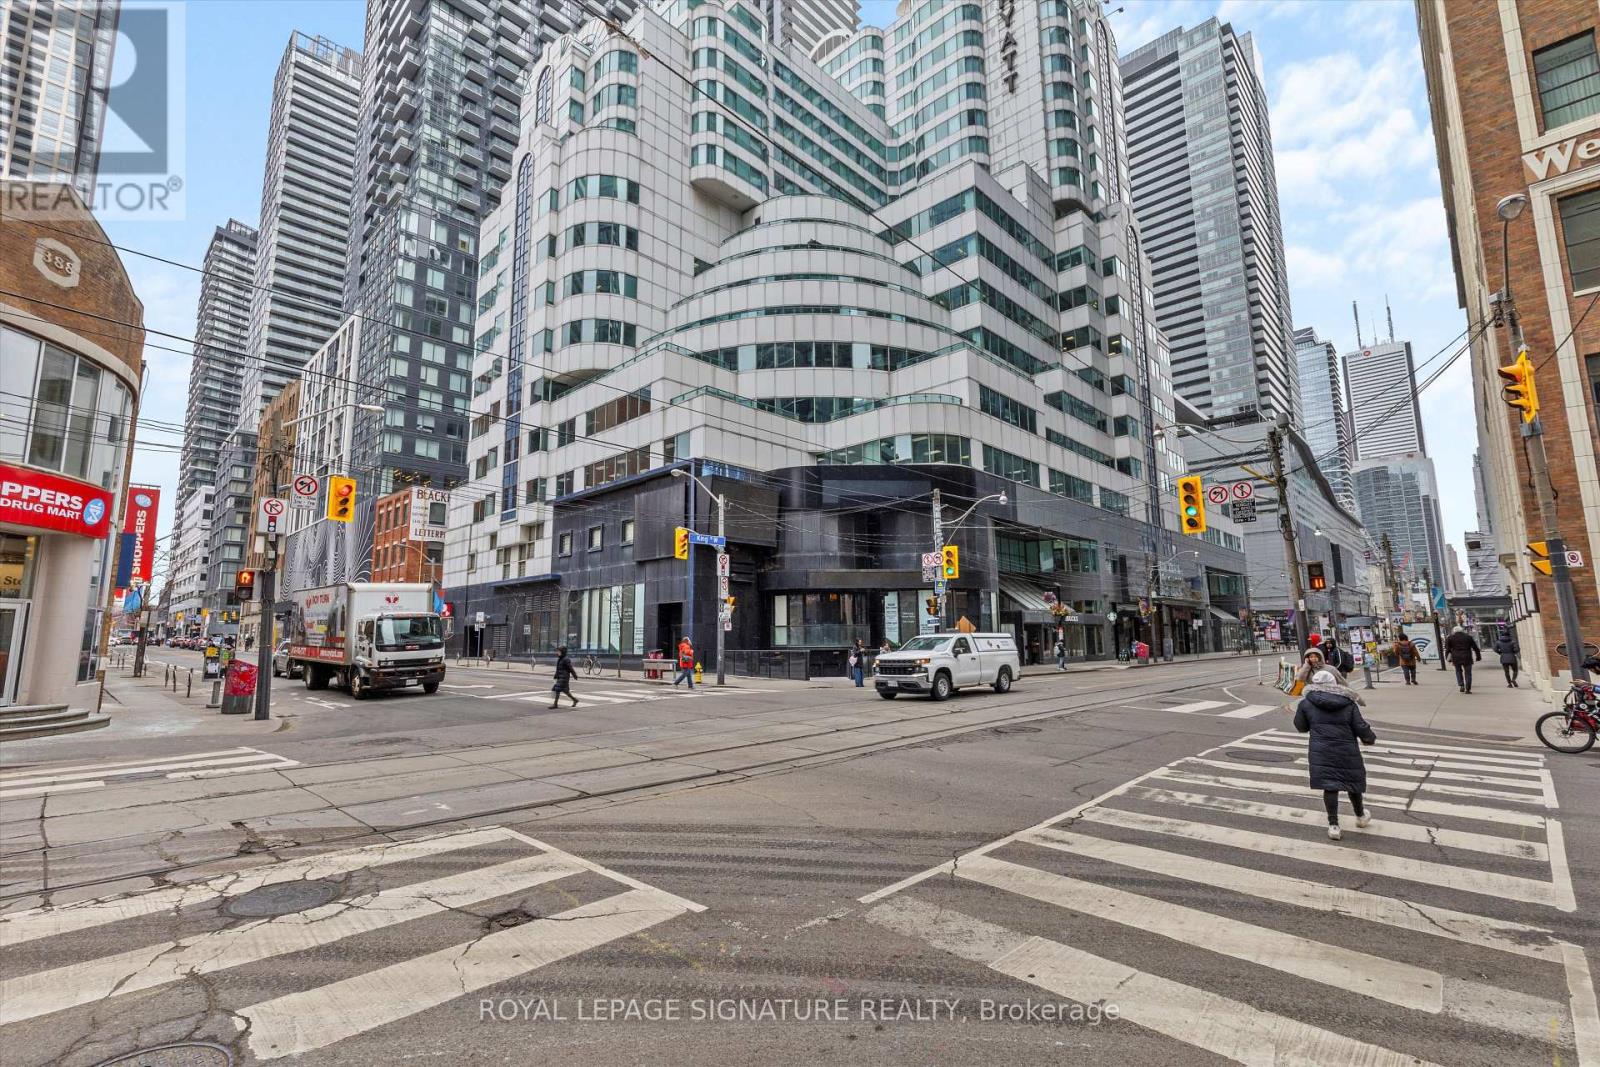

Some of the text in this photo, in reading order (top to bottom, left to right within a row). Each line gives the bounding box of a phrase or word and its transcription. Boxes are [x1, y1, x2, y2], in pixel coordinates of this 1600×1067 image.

[1521, 138, 1600, 180] We
[43, 251, 75, 275] 388
[0, 481, 83, 510] PPERS
[0, 497, 82, 520] DRUG MART
[131, 509, 147, 575] SHOPPERS
[696, 535, 709, 543] King
